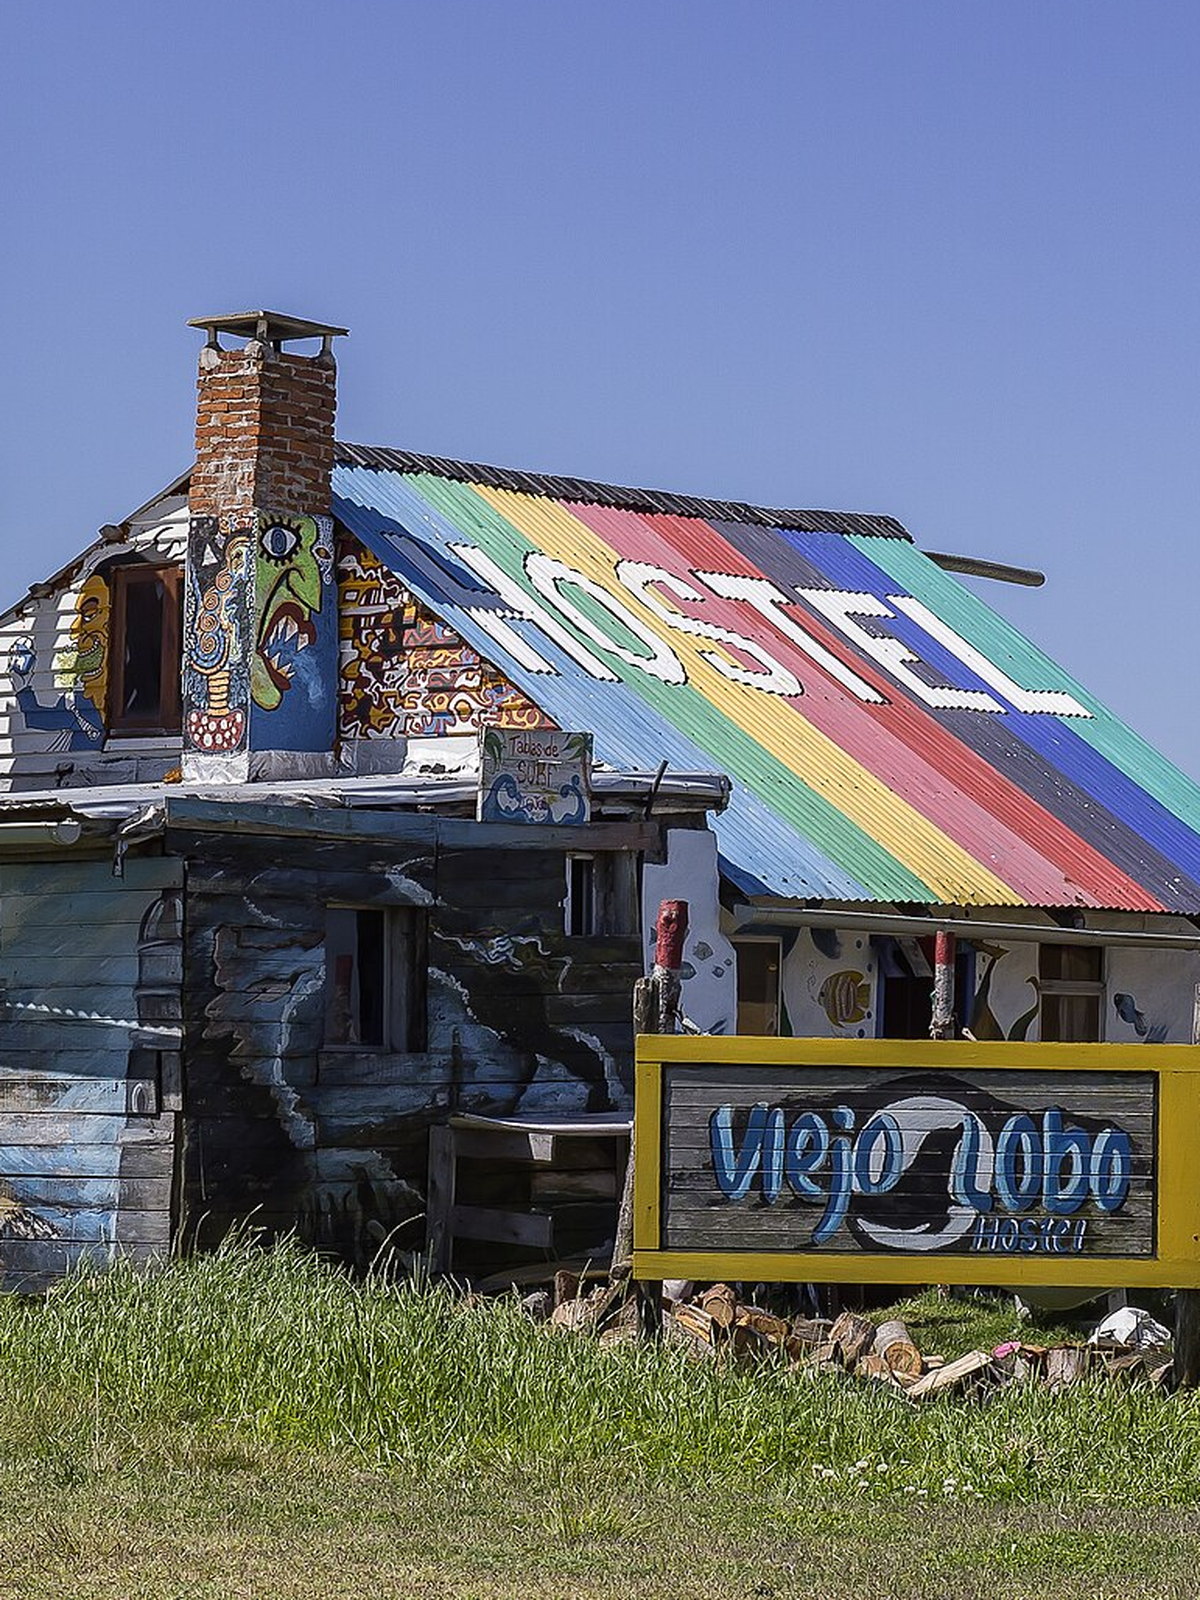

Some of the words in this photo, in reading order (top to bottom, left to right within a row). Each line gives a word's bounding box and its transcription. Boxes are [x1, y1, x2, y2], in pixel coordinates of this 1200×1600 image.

[381, 530, 1095, 719] HOSTEL
[508, 733, 542, 757] Tablas
[545, 735, 560, 758] de
[517, 761, 555, 788] SURF
